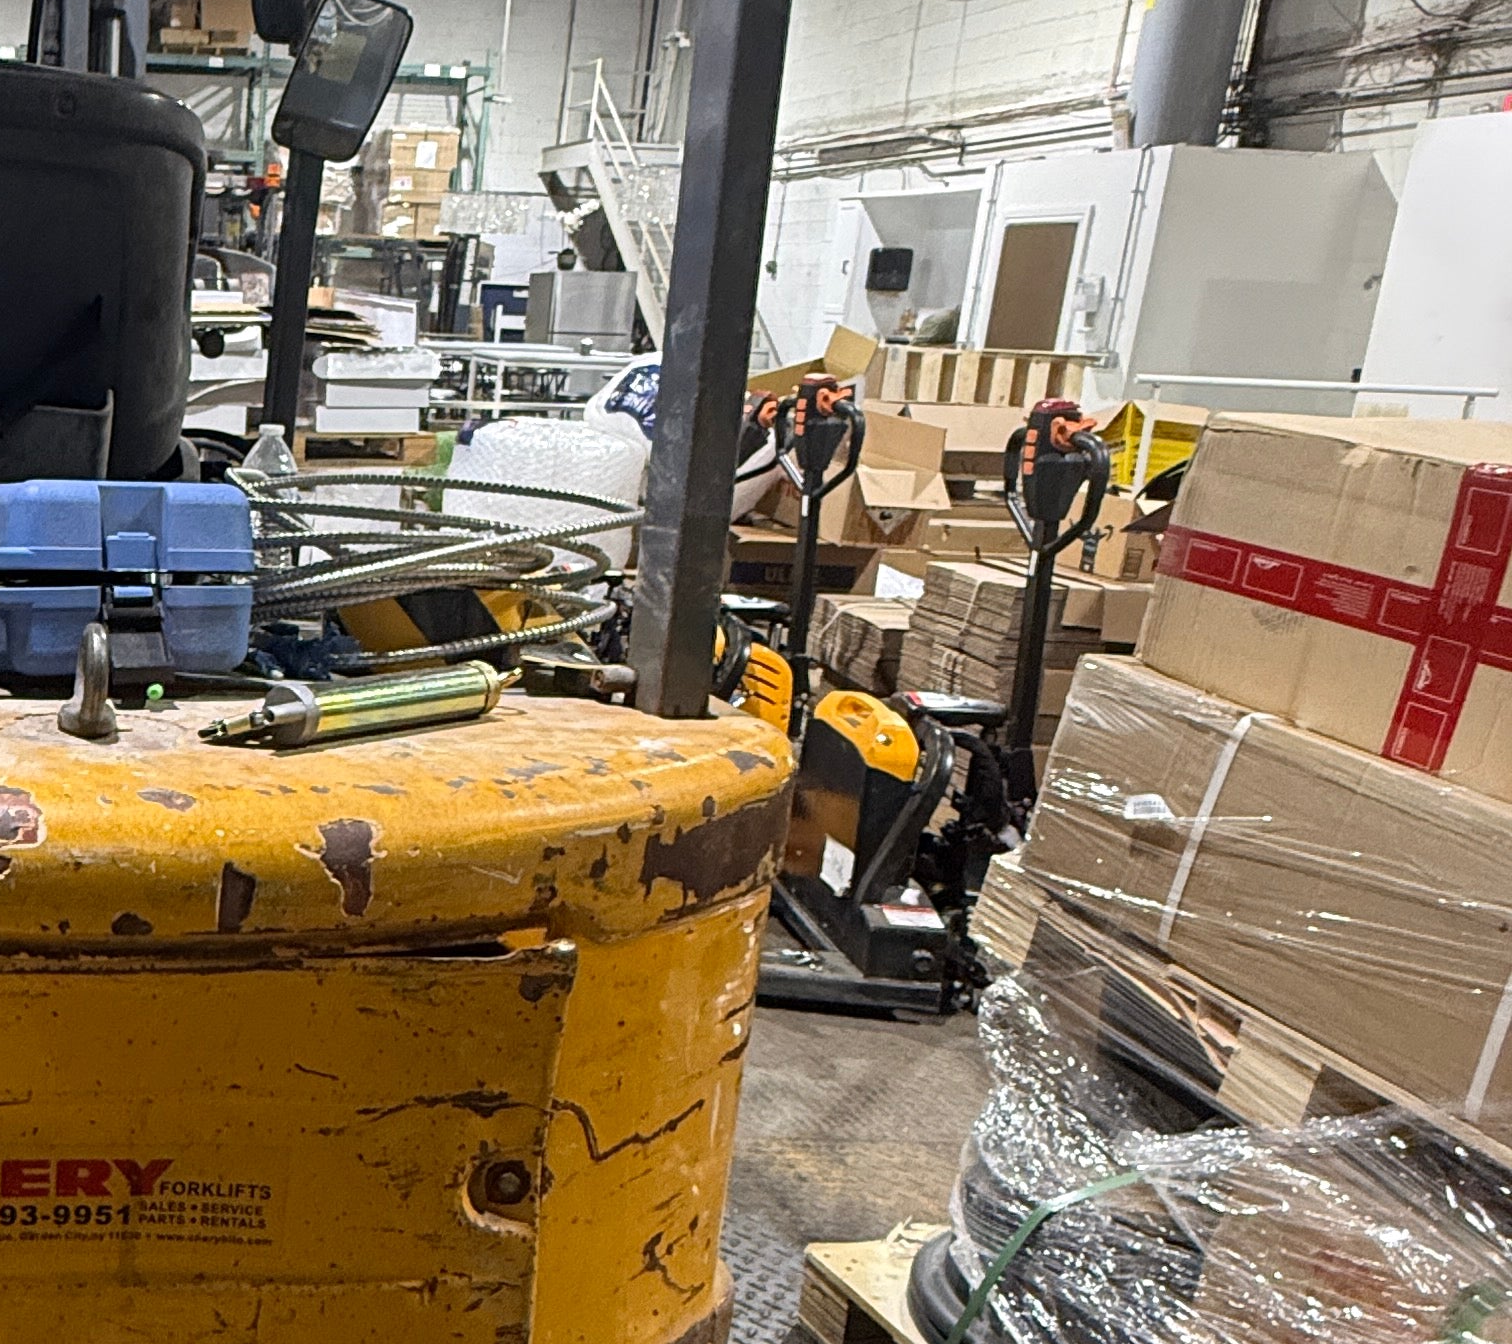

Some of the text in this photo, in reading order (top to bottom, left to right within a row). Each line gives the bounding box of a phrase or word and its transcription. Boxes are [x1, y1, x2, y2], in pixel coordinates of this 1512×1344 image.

[159, 1180, 272, 1201] FORKLIFTS
[138, 1199, 265, 1217] SALES SERVICE
[138, 1212, 267, 1230] PARTS RENTALS
